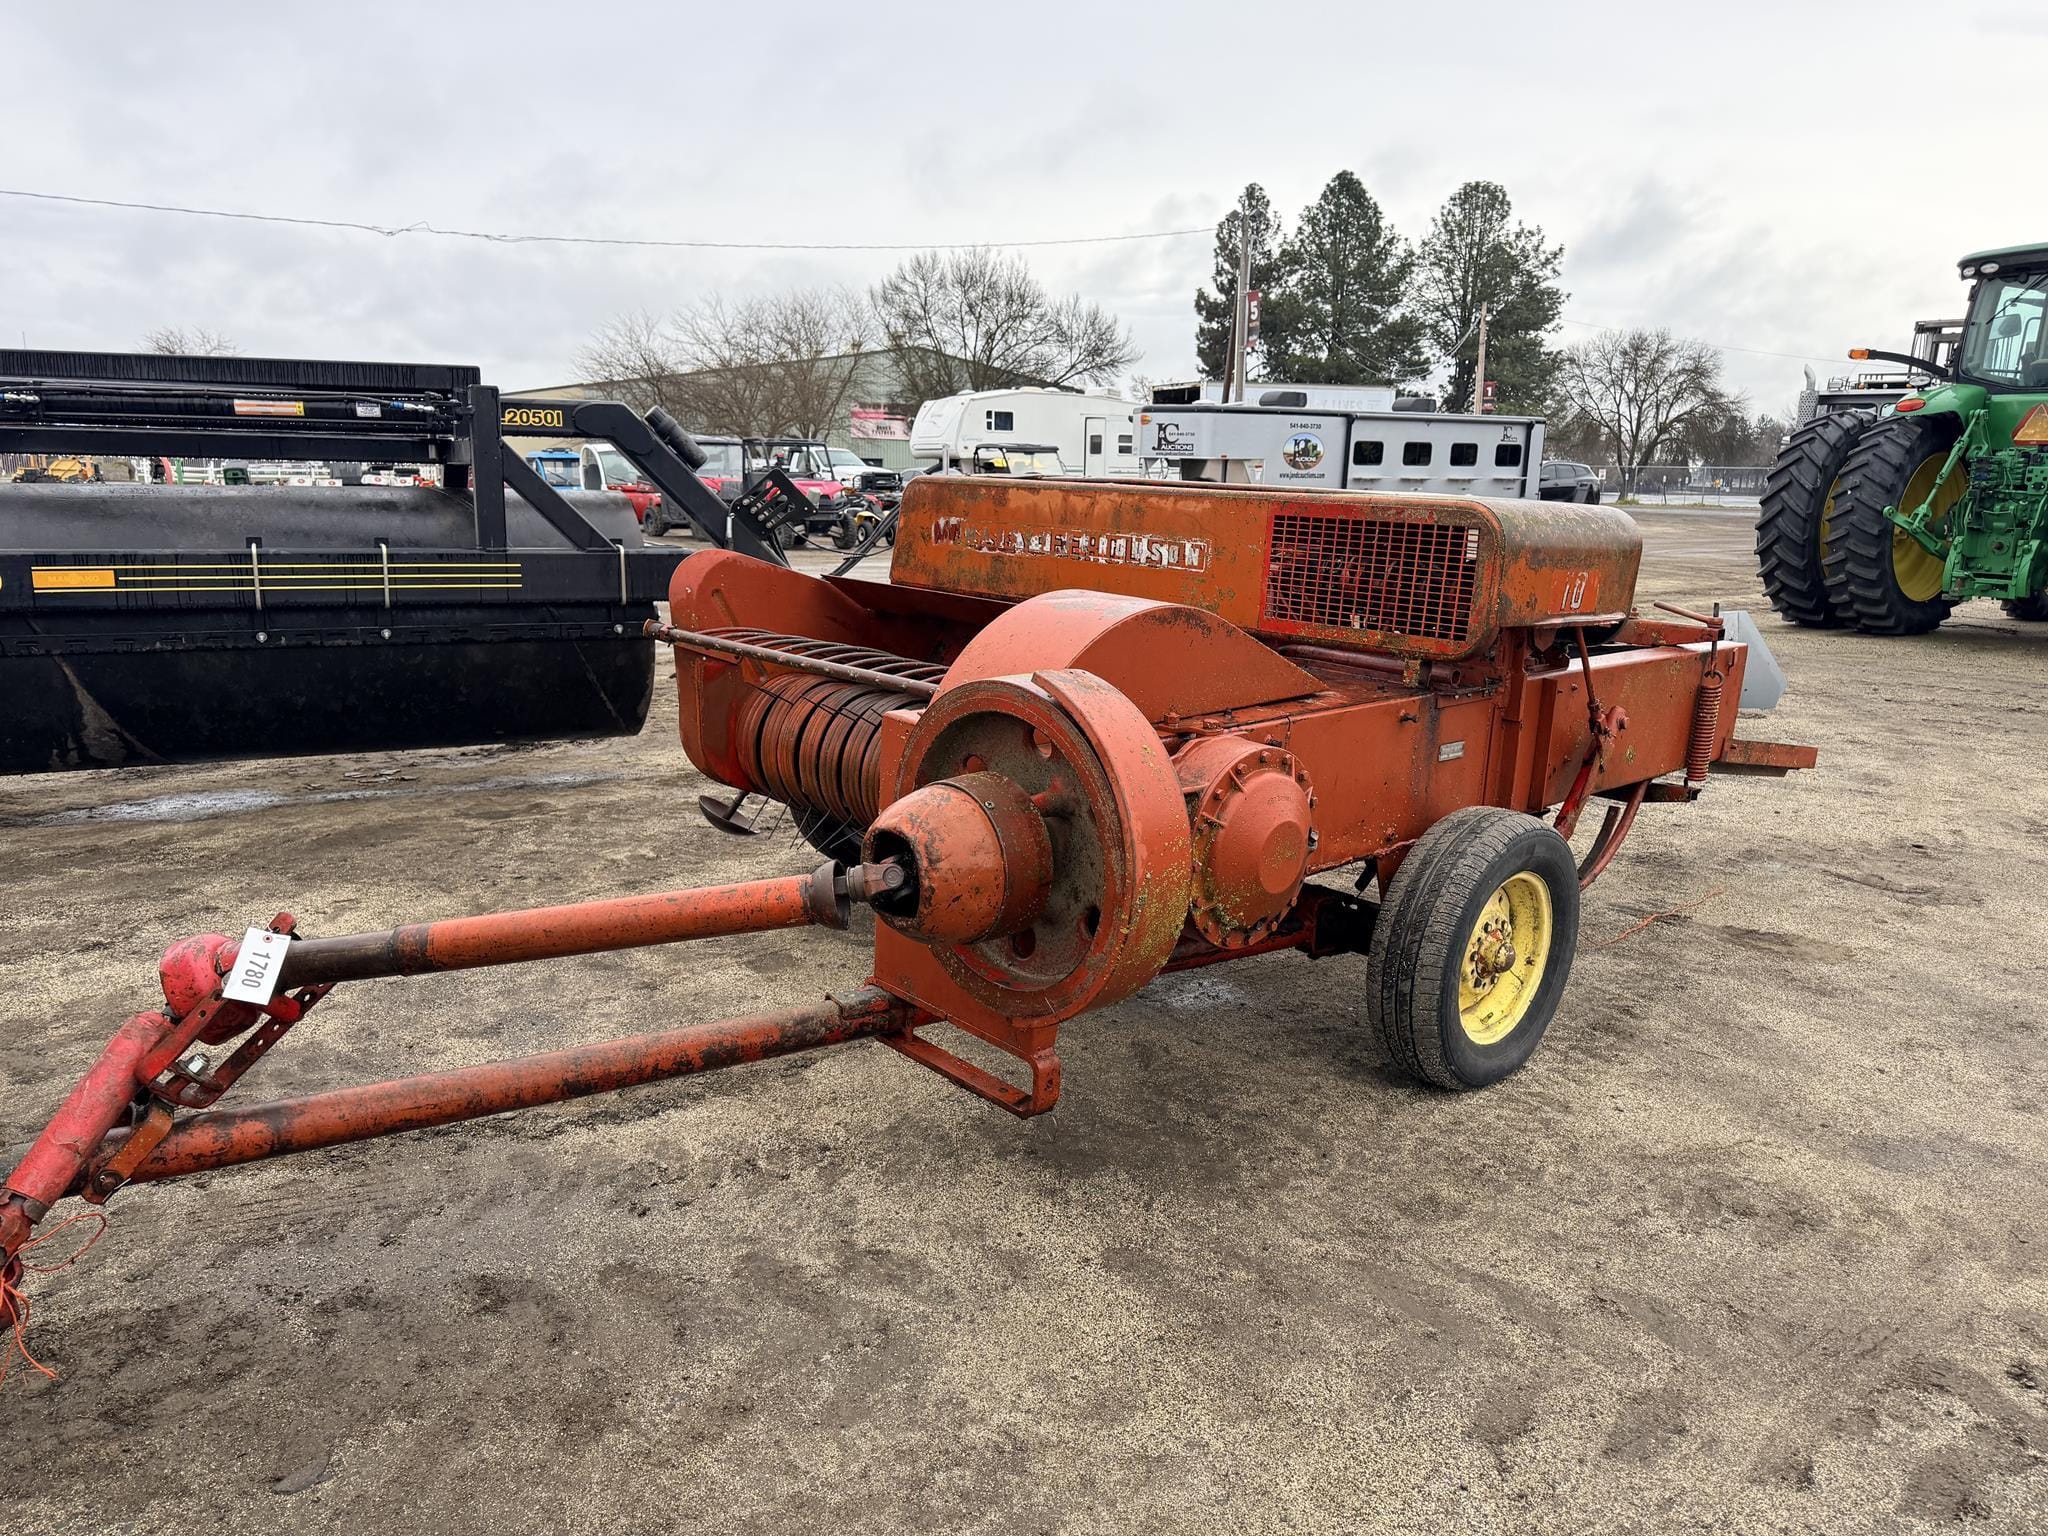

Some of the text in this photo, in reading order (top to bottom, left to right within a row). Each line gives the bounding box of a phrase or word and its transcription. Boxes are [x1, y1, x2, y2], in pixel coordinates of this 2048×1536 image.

[1250, 301, 1258, 320] 5
[1486, 387, 1492, 397] 1
[241, 951, 271, 989] 1780
